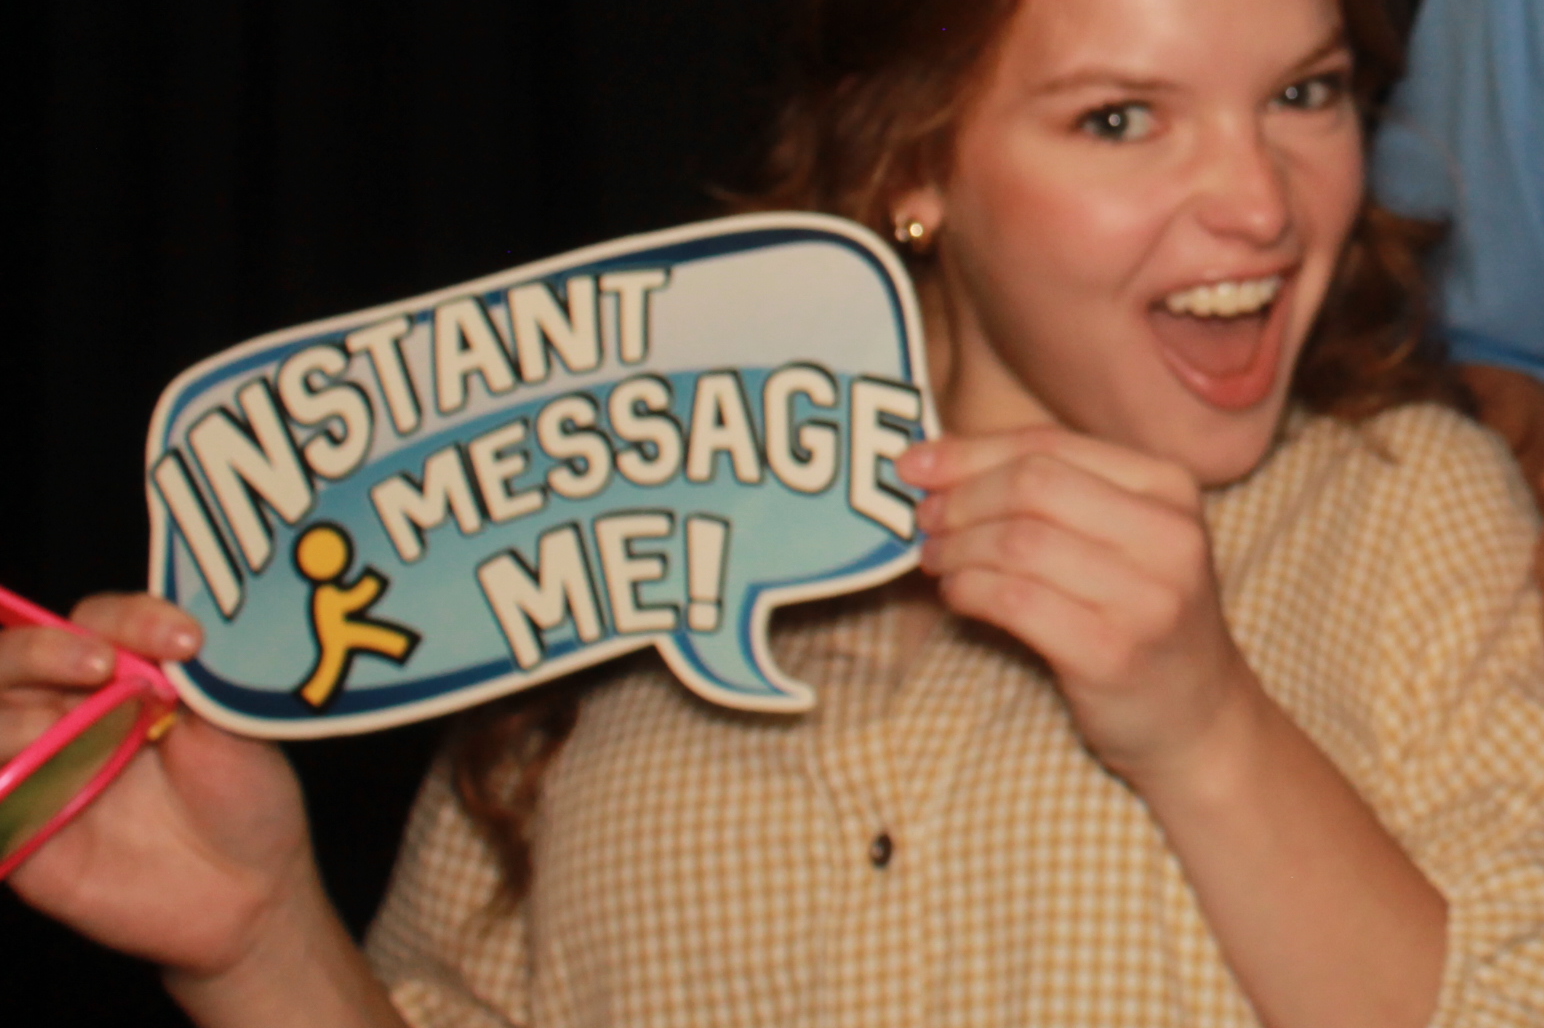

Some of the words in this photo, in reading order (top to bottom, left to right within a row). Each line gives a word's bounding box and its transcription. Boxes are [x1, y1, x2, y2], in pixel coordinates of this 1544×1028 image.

[153, 267, 673, 620] INSTANT
[369, 362, 922, 562] MESSAGE
[478, 507, 730, 671] ME!
